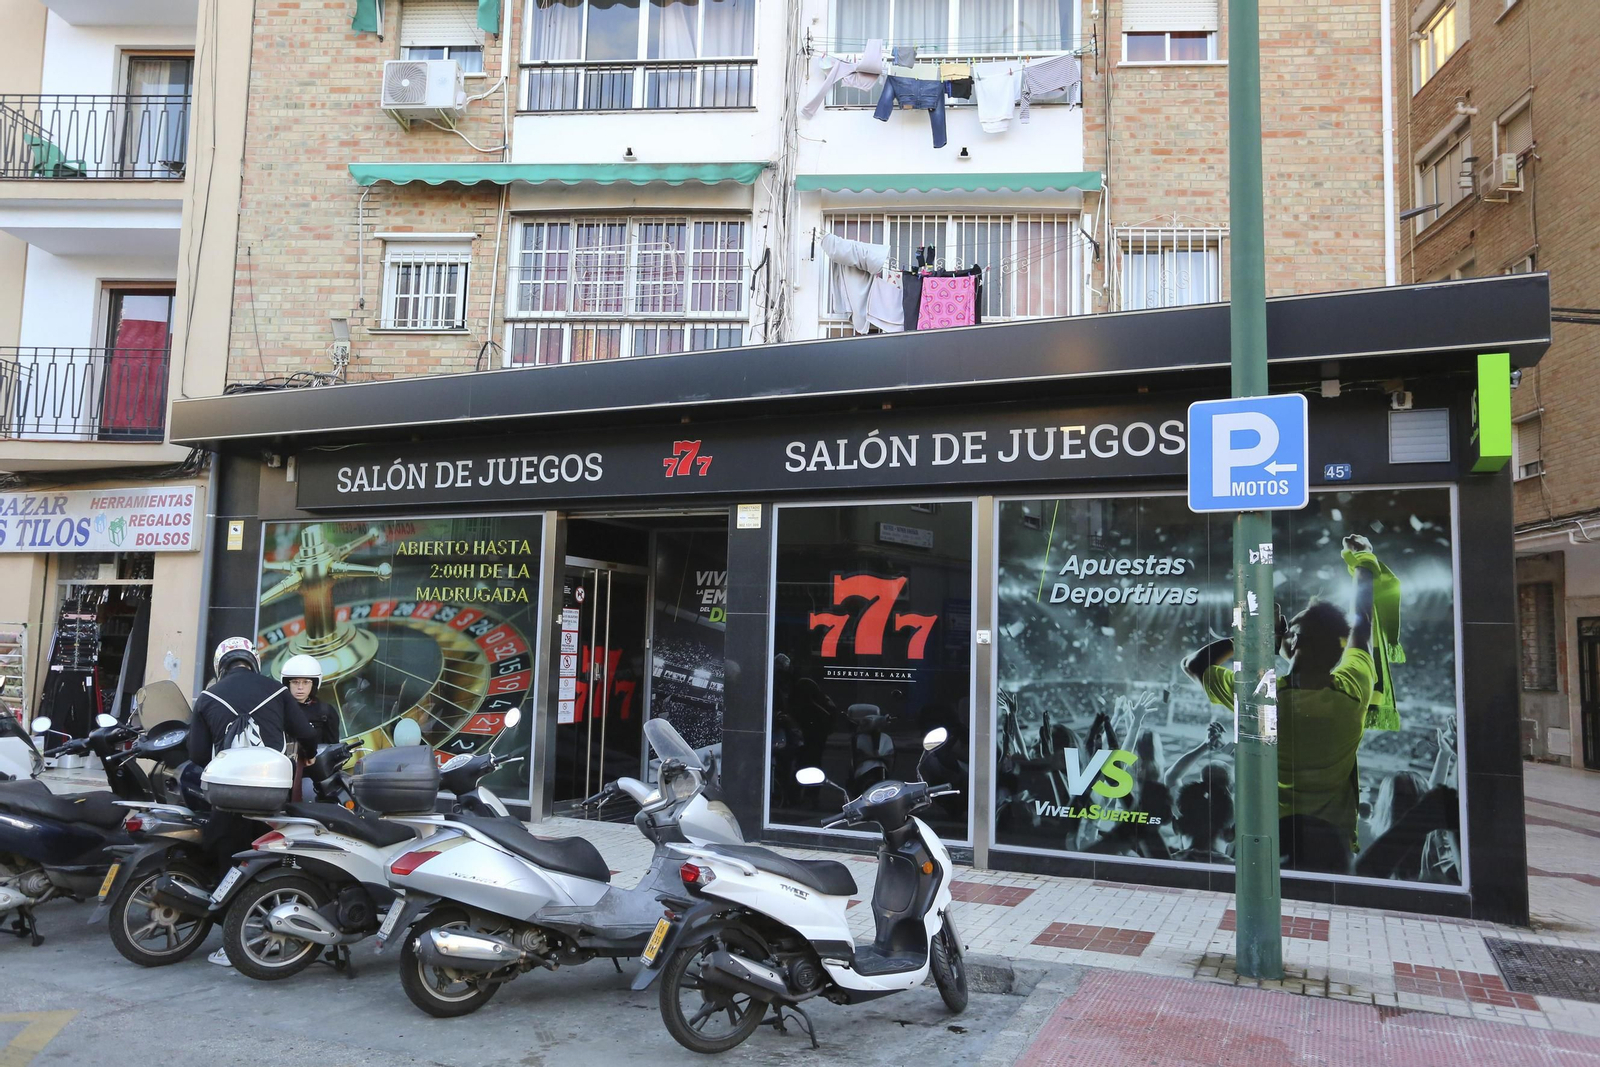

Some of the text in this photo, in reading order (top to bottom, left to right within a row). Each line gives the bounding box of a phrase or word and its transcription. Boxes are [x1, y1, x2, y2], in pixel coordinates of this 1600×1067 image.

[785, 419, 1186, 473] SALÓN DE JUEGOS
[1211, 411, 1280, 497] P
[663, 439, 713, 478] 777
[336, 452, 604, 493] SALÓN DE JUEGOS
[1231, 479, 1289, 497] MOTOS
[0, 496, 68, 516] AZAR
[90, 493, 193, 510] HERRAMIENTAS
[128, 512, 191, 527] REGALOS
[16, 517, 91, 547] TILOS
[135, 531, 190, 546] BOLSOS
[396, 539, 532, 556] ABIERTO HASTA
[430, 563, 531, 579] 2:00H DE LA
[1059, 554, 1186, 579] Apuestas
[696, 570, 727, 586] VIV
[415, 586, 530, 602] MADRUGADA
[1049, 582, 1199, 607] Deportivas
[456, 612, 474, 626] 3
[809, 574, 938, 660] 777
[469, 619, 493, 636] 26
[493, 642, 517, 660] 32
[499, 657, 521, 675] 15
[826, 670, 870, 678] DISFRUTA
[497, 675, 522, 690] 19
[488, 699, 512, 709] 4
[471, 717, 500, 732] 21
[1063, 746, 1139, 799] VS
[779, 883, 810, 897] TWEET
